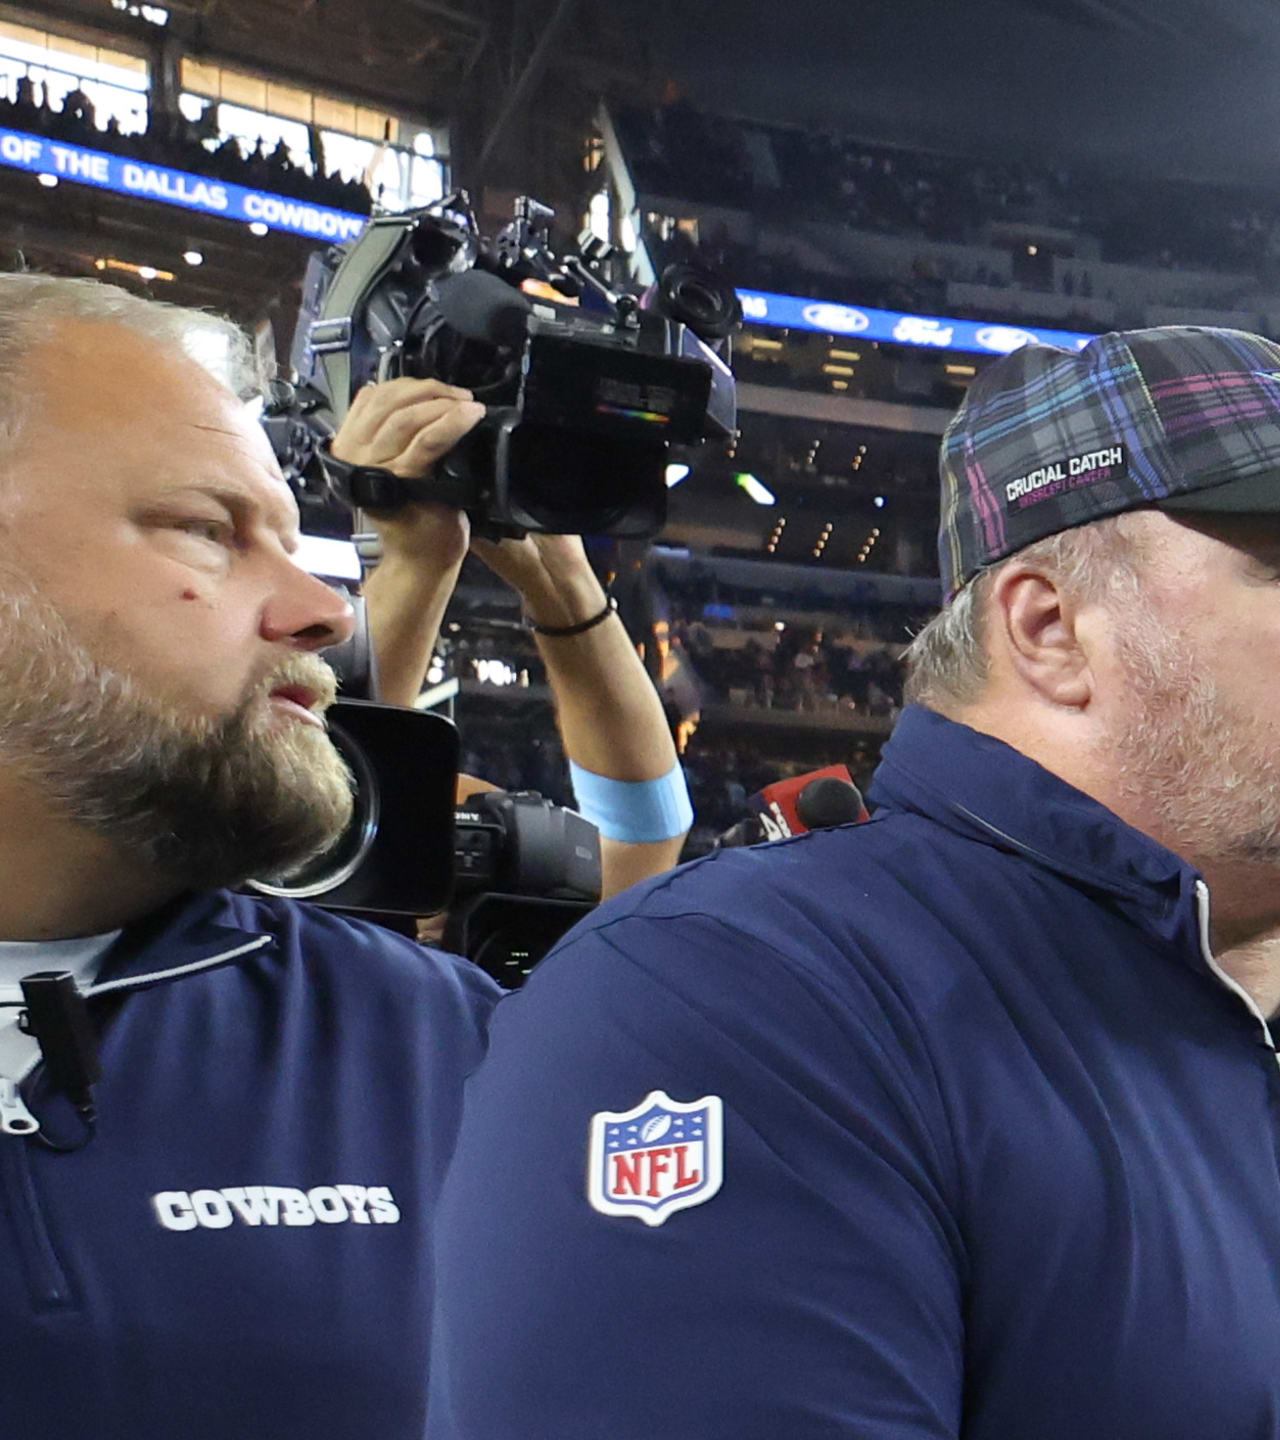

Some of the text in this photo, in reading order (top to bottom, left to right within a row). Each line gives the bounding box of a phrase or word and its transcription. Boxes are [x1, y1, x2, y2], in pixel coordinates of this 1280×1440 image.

[1, 134, 42, 165] OF
[52, 147, 109, 183] THE
[123, 165, 229, 210] DALLAS
[1006, 447, 1122, 502] CRUCIAL CATCH
[611, 1143, 699, 1198] NFL
[153, 1184, 401, 1231] COWBOYS
